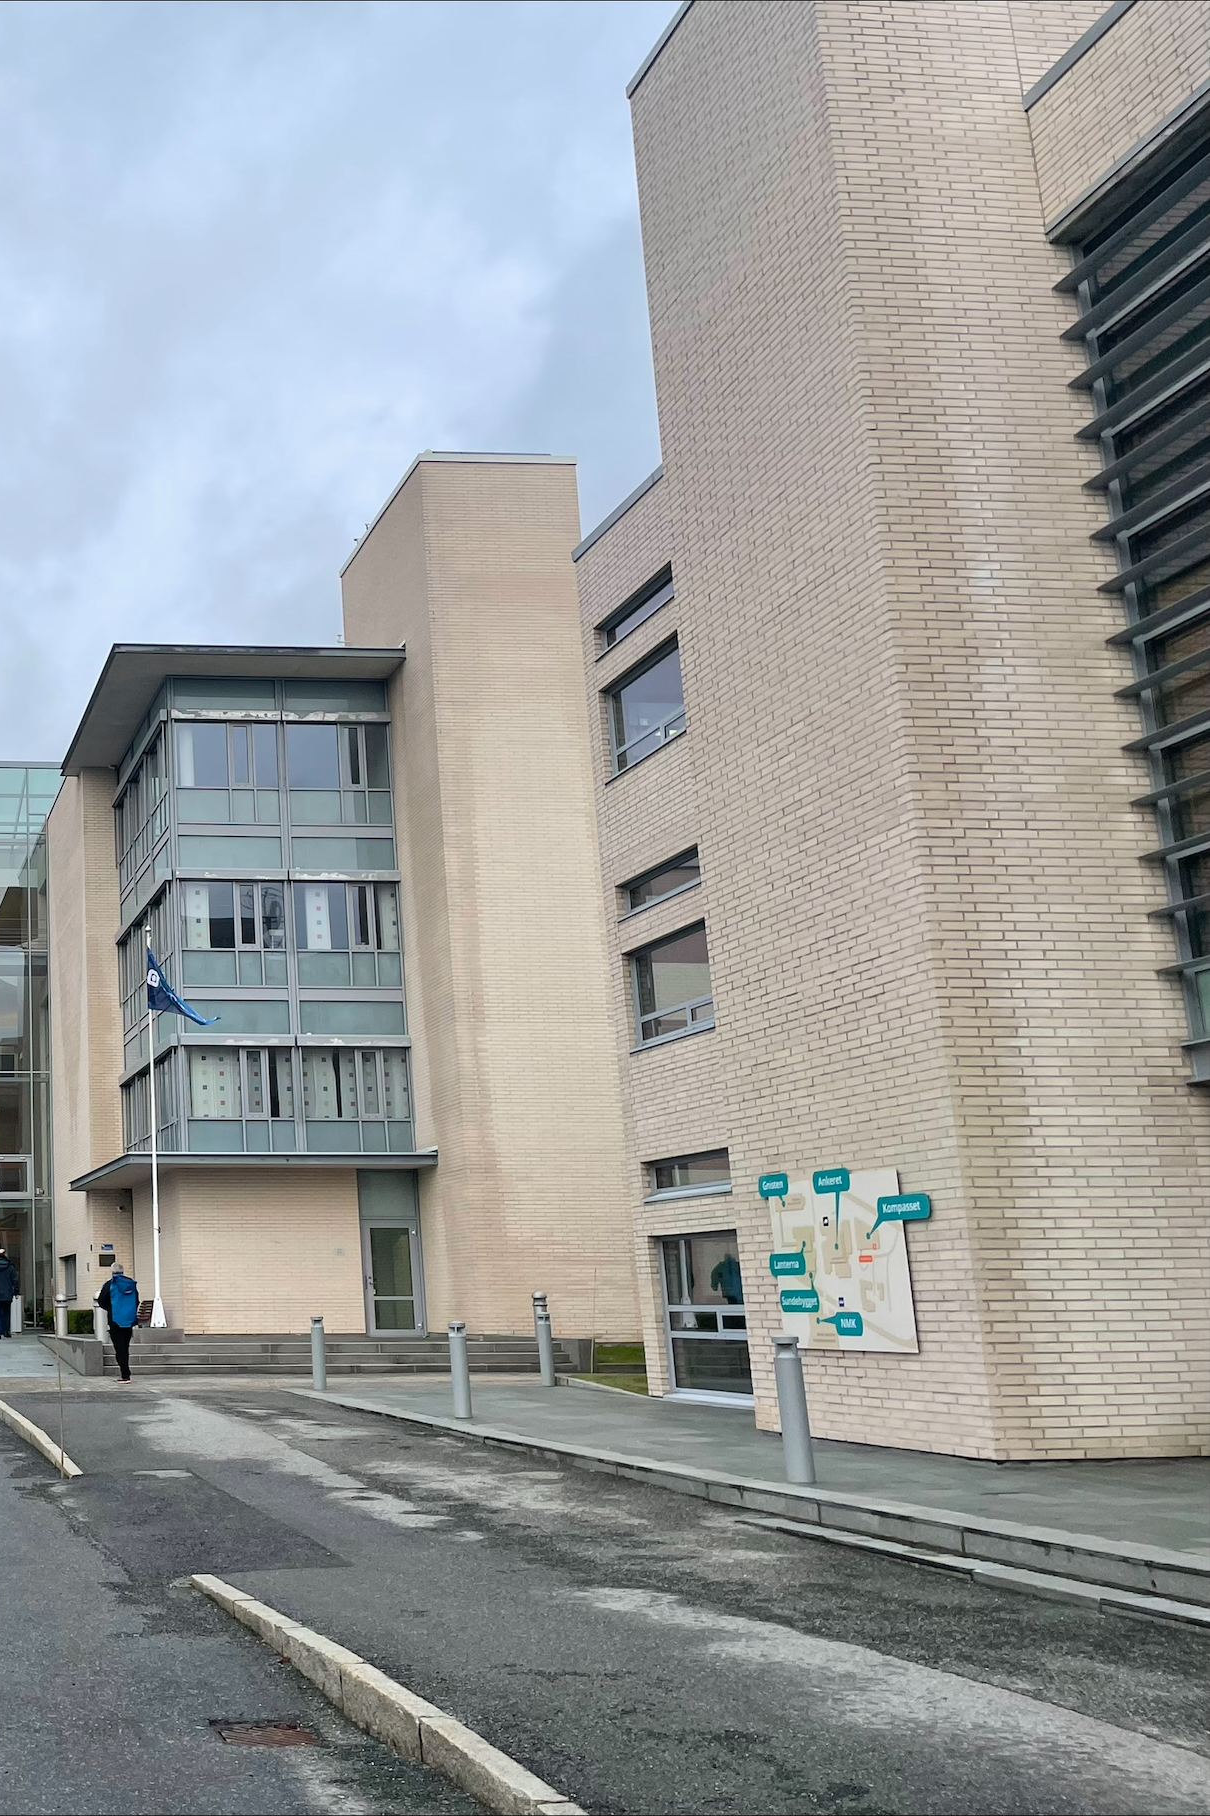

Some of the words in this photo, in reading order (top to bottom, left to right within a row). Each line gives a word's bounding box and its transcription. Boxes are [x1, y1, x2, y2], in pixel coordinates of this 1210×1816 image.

[762, 1180, 784, 1190] Gnisten
[818, 1176, 843, 1187] Ankeret
[882, 1201, 921, 1214] Kompasset
[773, 1260, 800, 1270] Lanterna
[781, 1296, 818, 1309] Sundebygget
[840, 1318, 857, 1329] NMK
